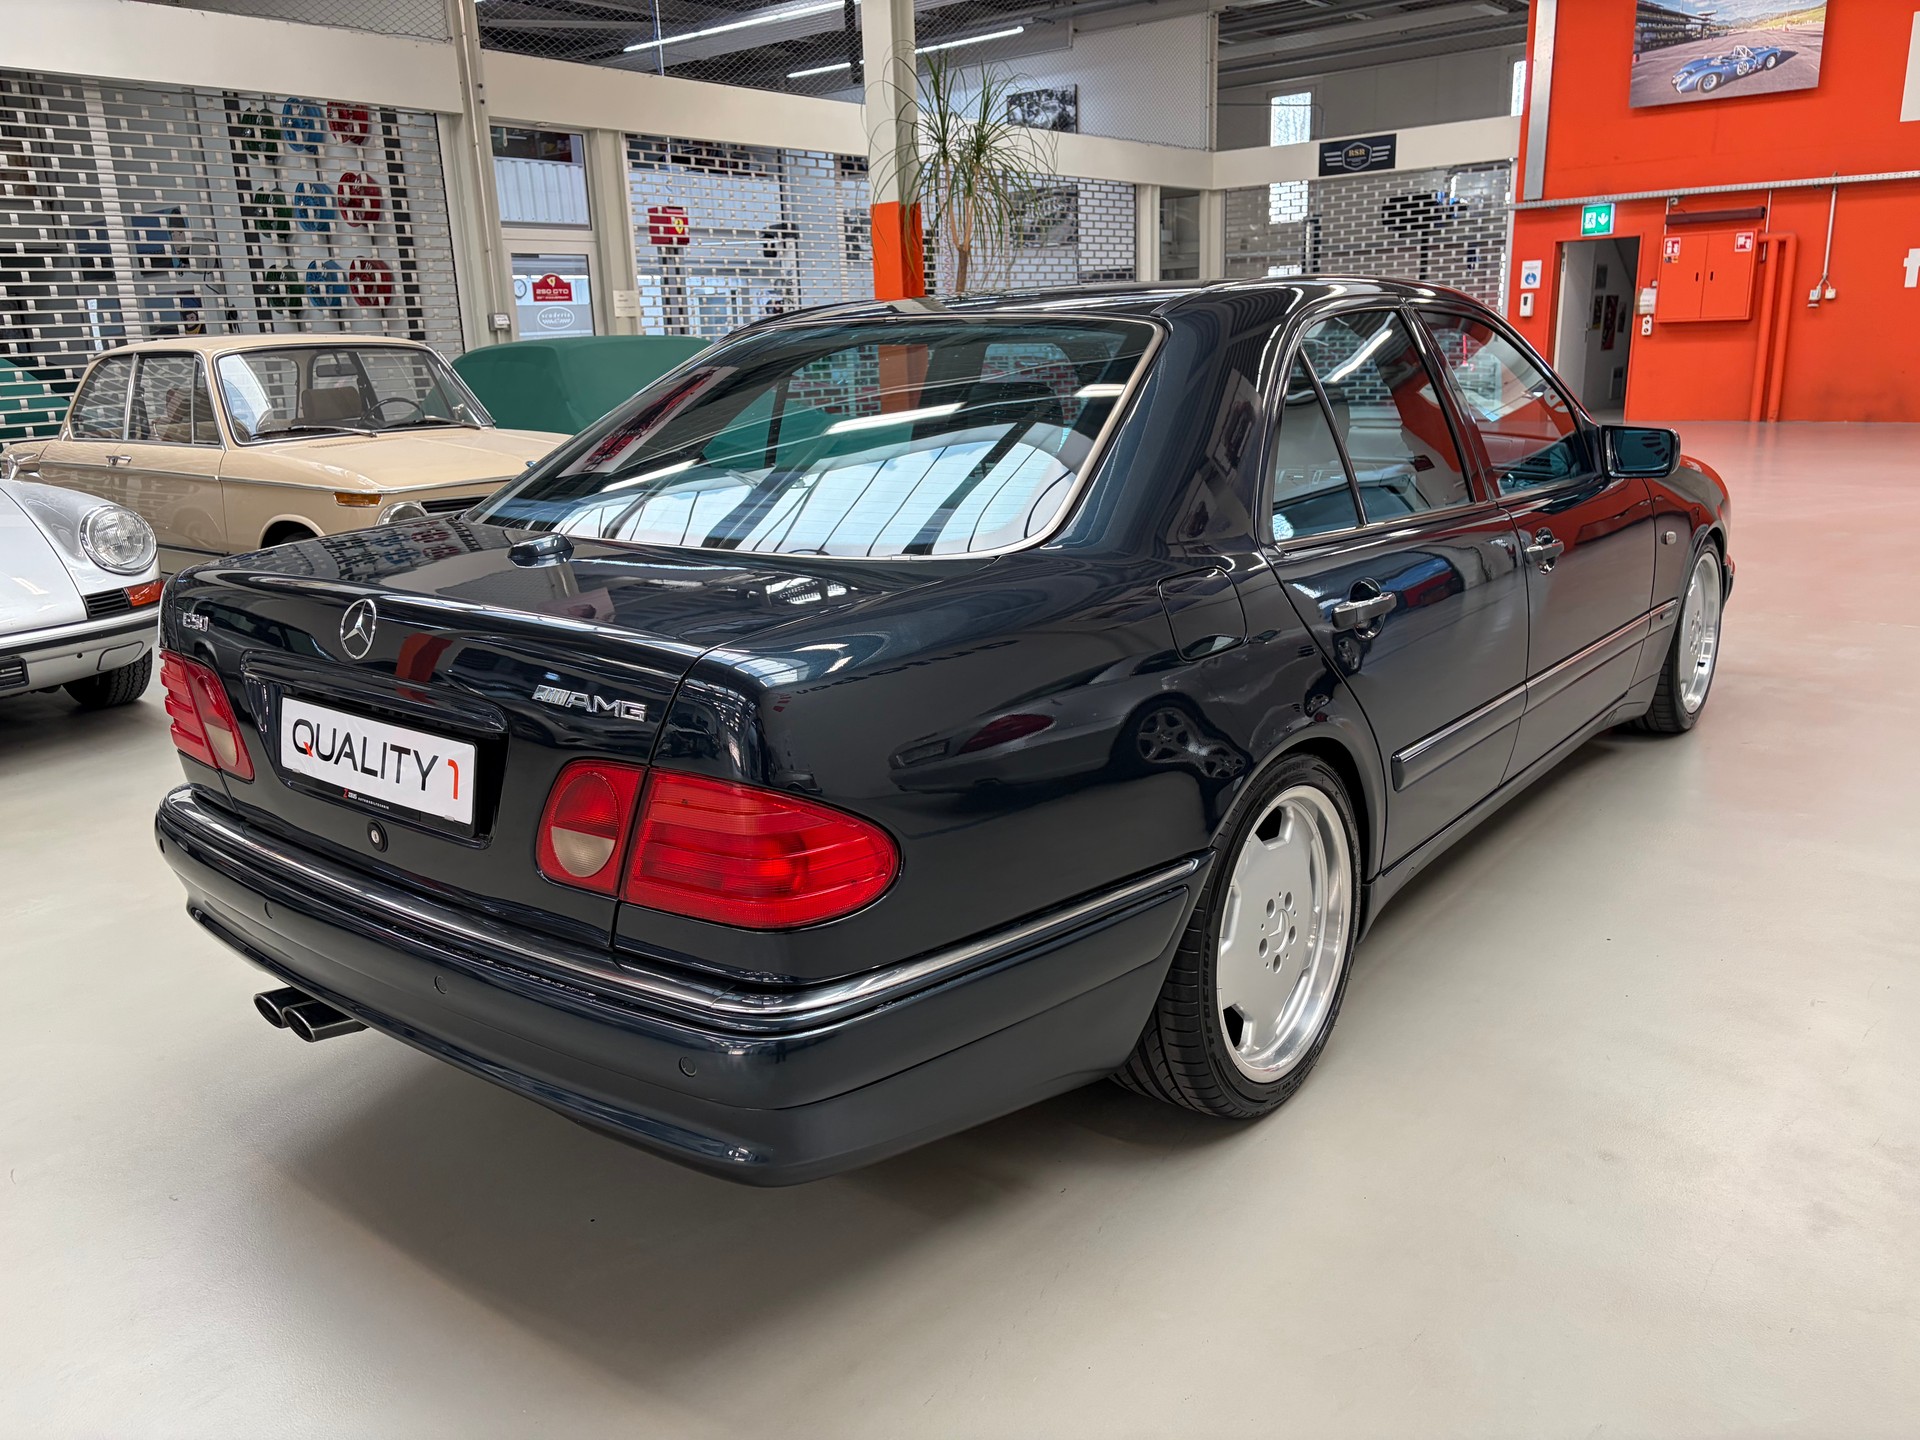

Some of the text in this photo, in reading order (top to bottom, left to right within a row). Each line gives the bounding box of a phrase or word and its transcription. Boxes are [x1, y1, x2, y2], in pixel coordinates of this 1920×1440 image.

[1348, 148, 1366, 157] RSR
[565, 691, 648, 722] AMG
[292, 718, 459, 800] QUALITY 1
